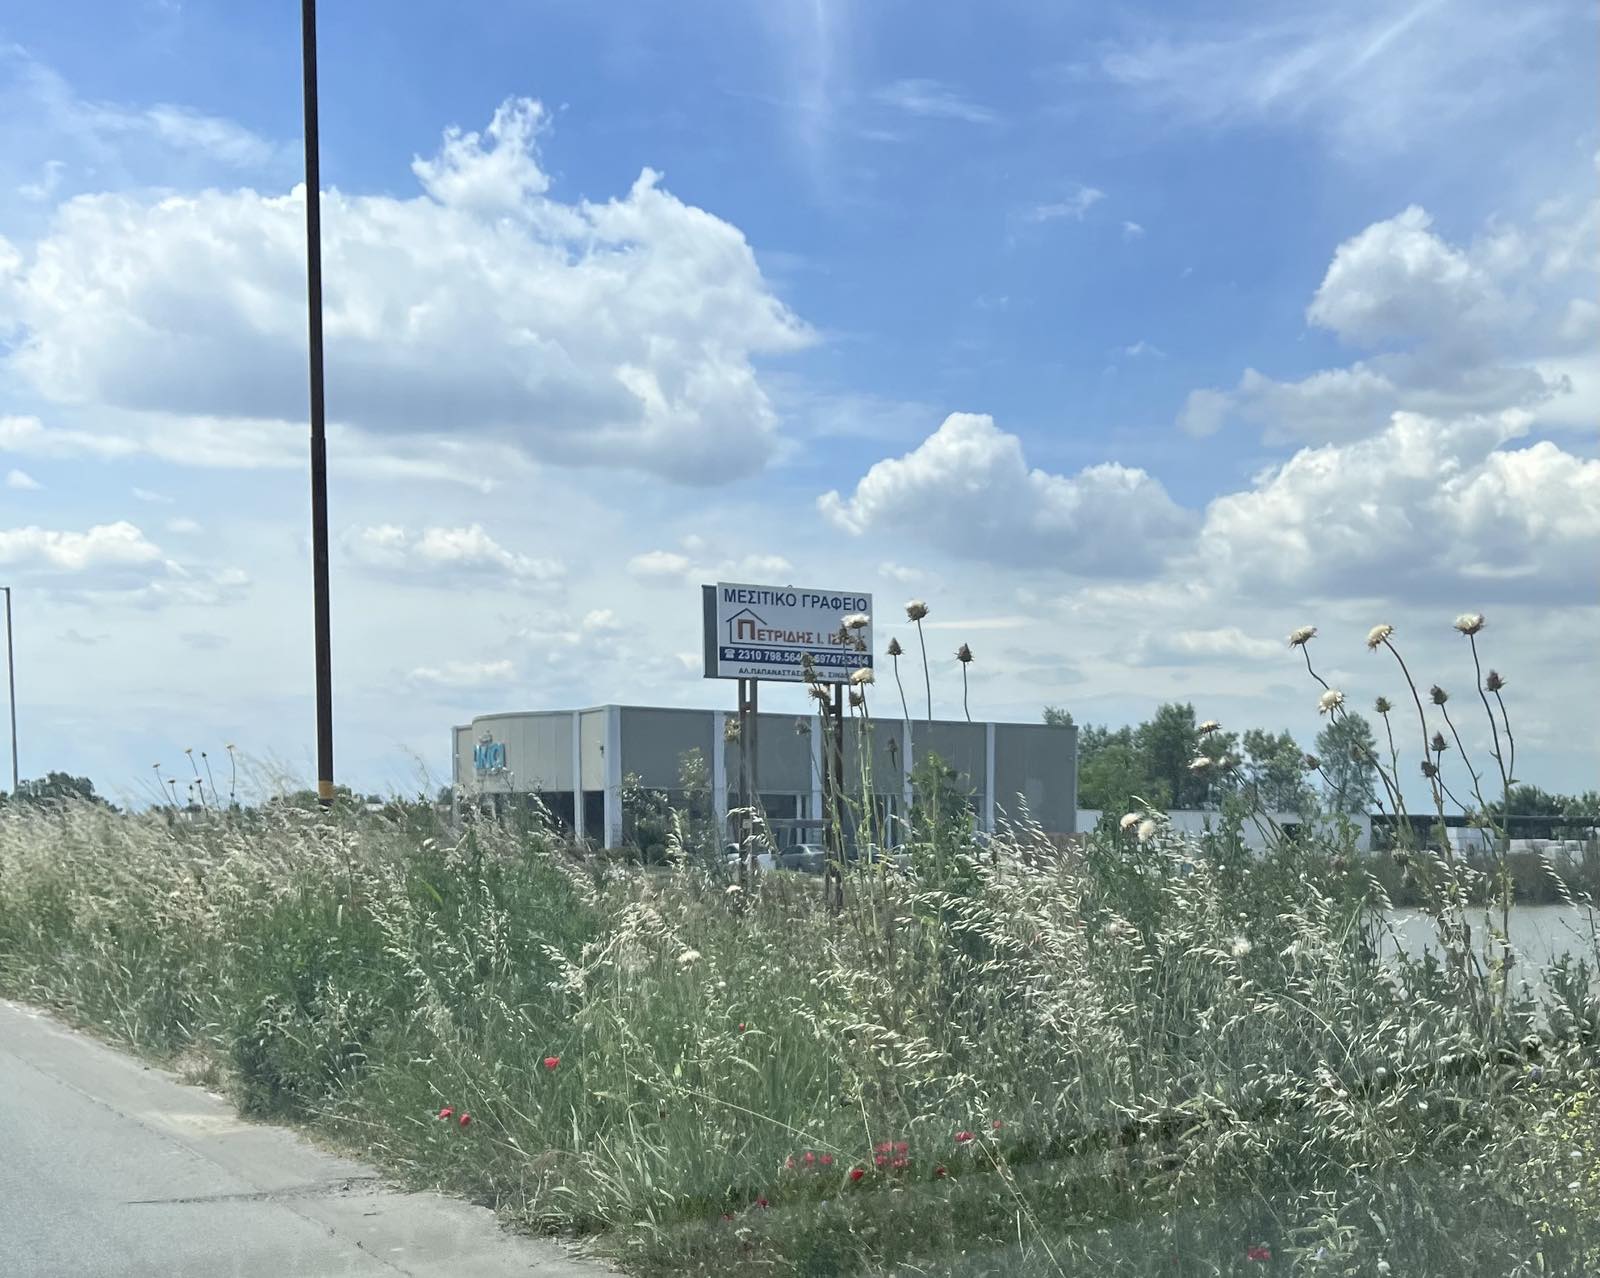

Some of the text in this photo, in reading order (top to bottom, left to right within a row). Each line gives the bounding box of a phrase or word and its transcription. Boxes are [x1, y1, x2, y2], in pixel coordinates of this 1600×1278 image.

[724, 588, 867, 612] ΜΕΣΙΤΙΚΟ ΓΡΑΦΕΙΟ
[737, 618, 814, 644] ΠΕΤΡΙΔΗΣ
[738, 649, 761, 660] 2310
